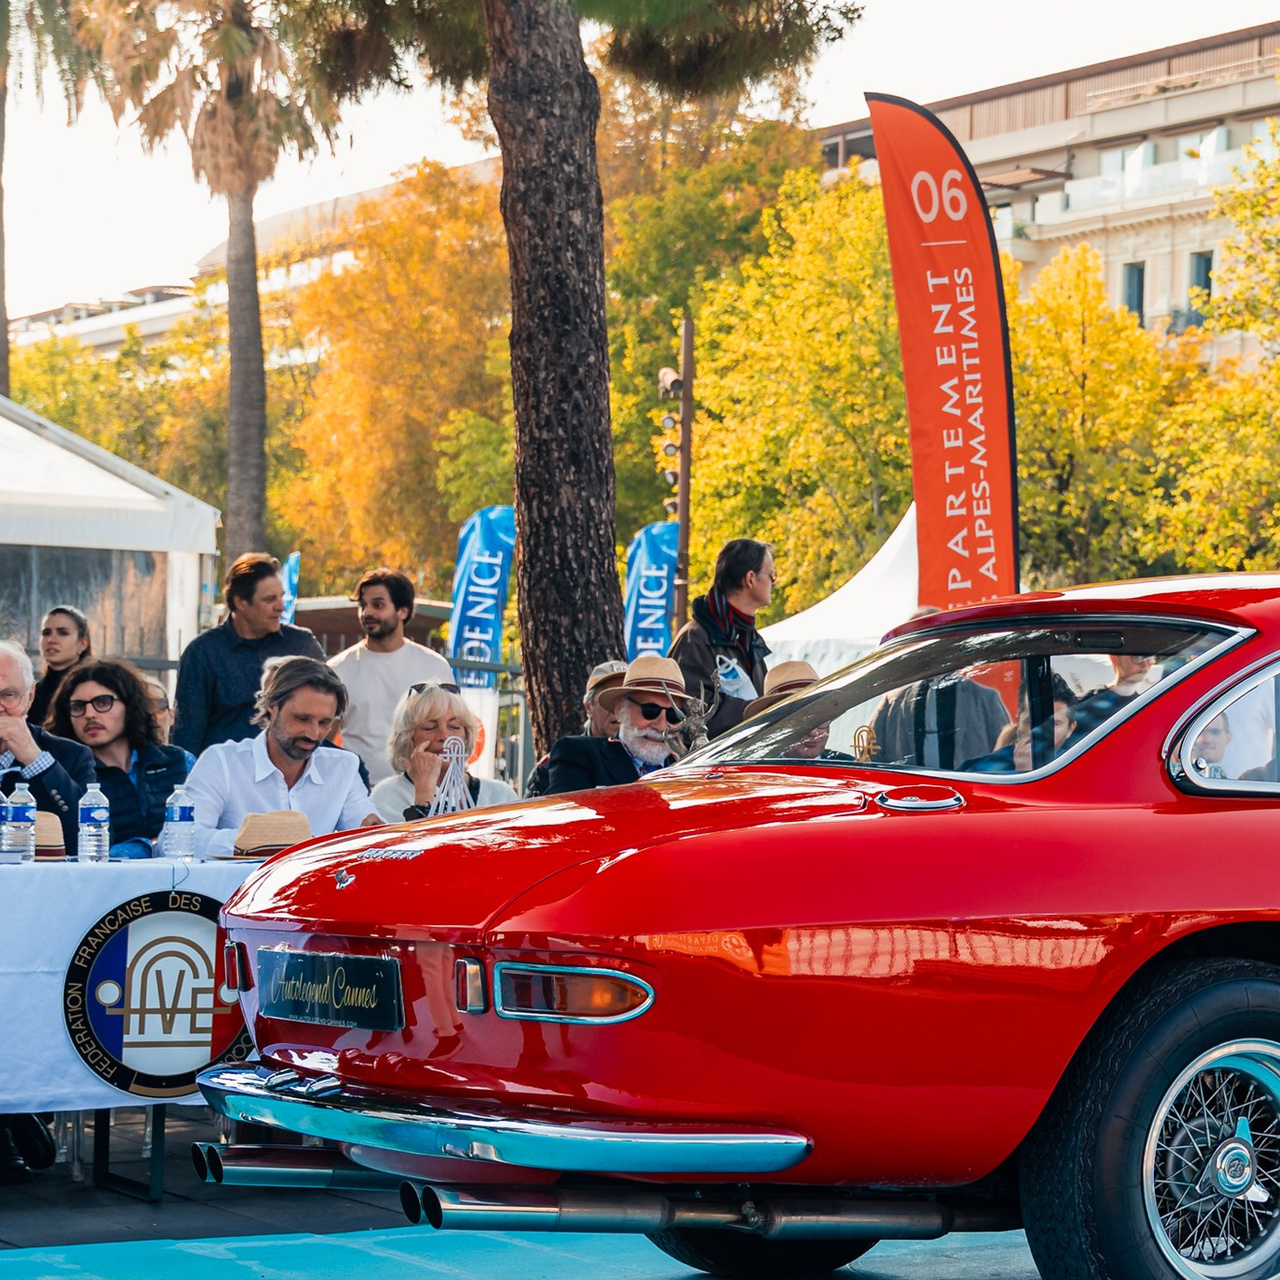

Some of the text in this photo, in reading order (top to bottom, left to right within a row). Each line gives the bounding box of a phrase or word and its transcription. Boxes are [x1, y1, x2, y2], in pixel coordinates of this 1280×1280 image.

[911, 169, 968, 223] 06
[926, 269, 973, 610] PARTEMENT
[953, 266, 998, 582] ALPES-MARITIMES
[466, 549, 503, 620] NICE
[638, 563, 669, 630] NICE
[67, 893, 202, 1079] FEDERATION FRANÇAISE DES
[270, 963, 378, 1013] Autolegend Cannes
